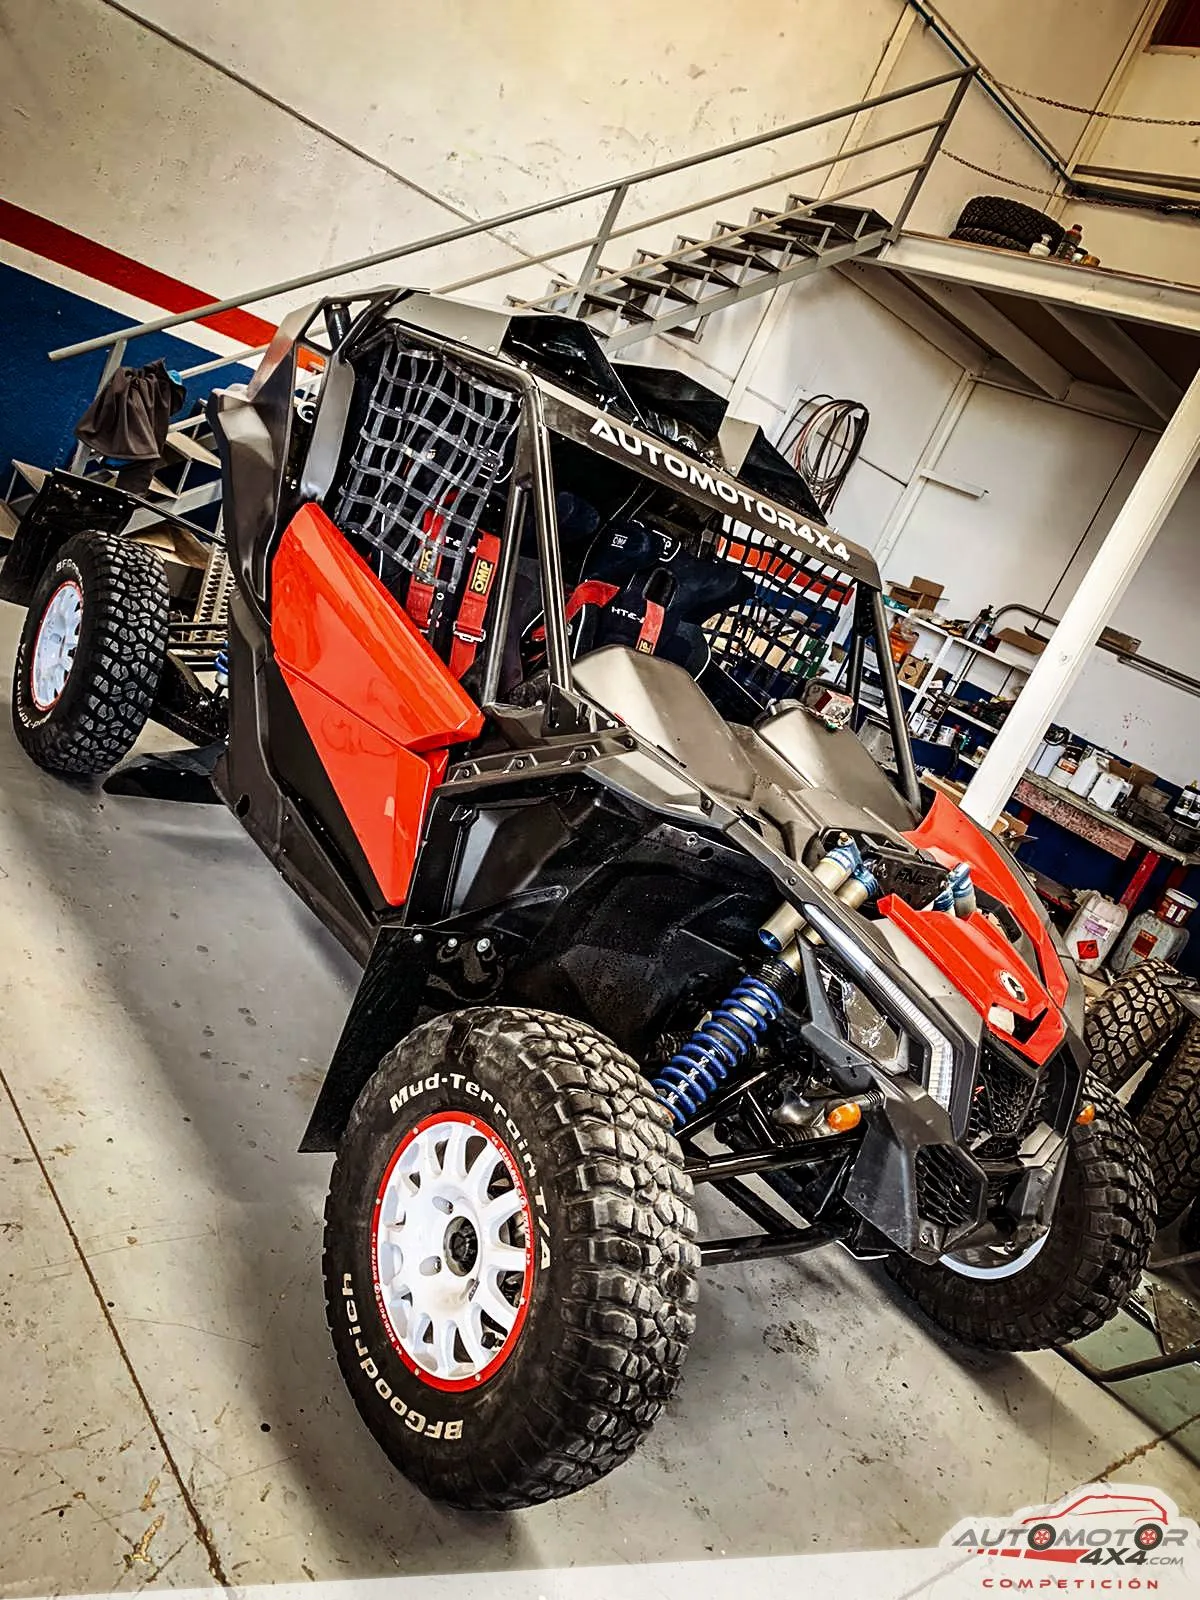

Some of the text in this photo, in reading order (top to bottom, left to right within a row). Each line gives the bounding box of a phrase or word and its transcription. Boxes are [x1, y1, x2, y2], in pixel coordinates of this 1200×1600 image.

[589, 417, 851, 562] AUTOMOTOR4X4
[473, 560, 491, 593] OMP
[389, 1072, 551, 1270] Mud-Terrain T/A
[342, 1273, 463, 1440] BFGoodrich
